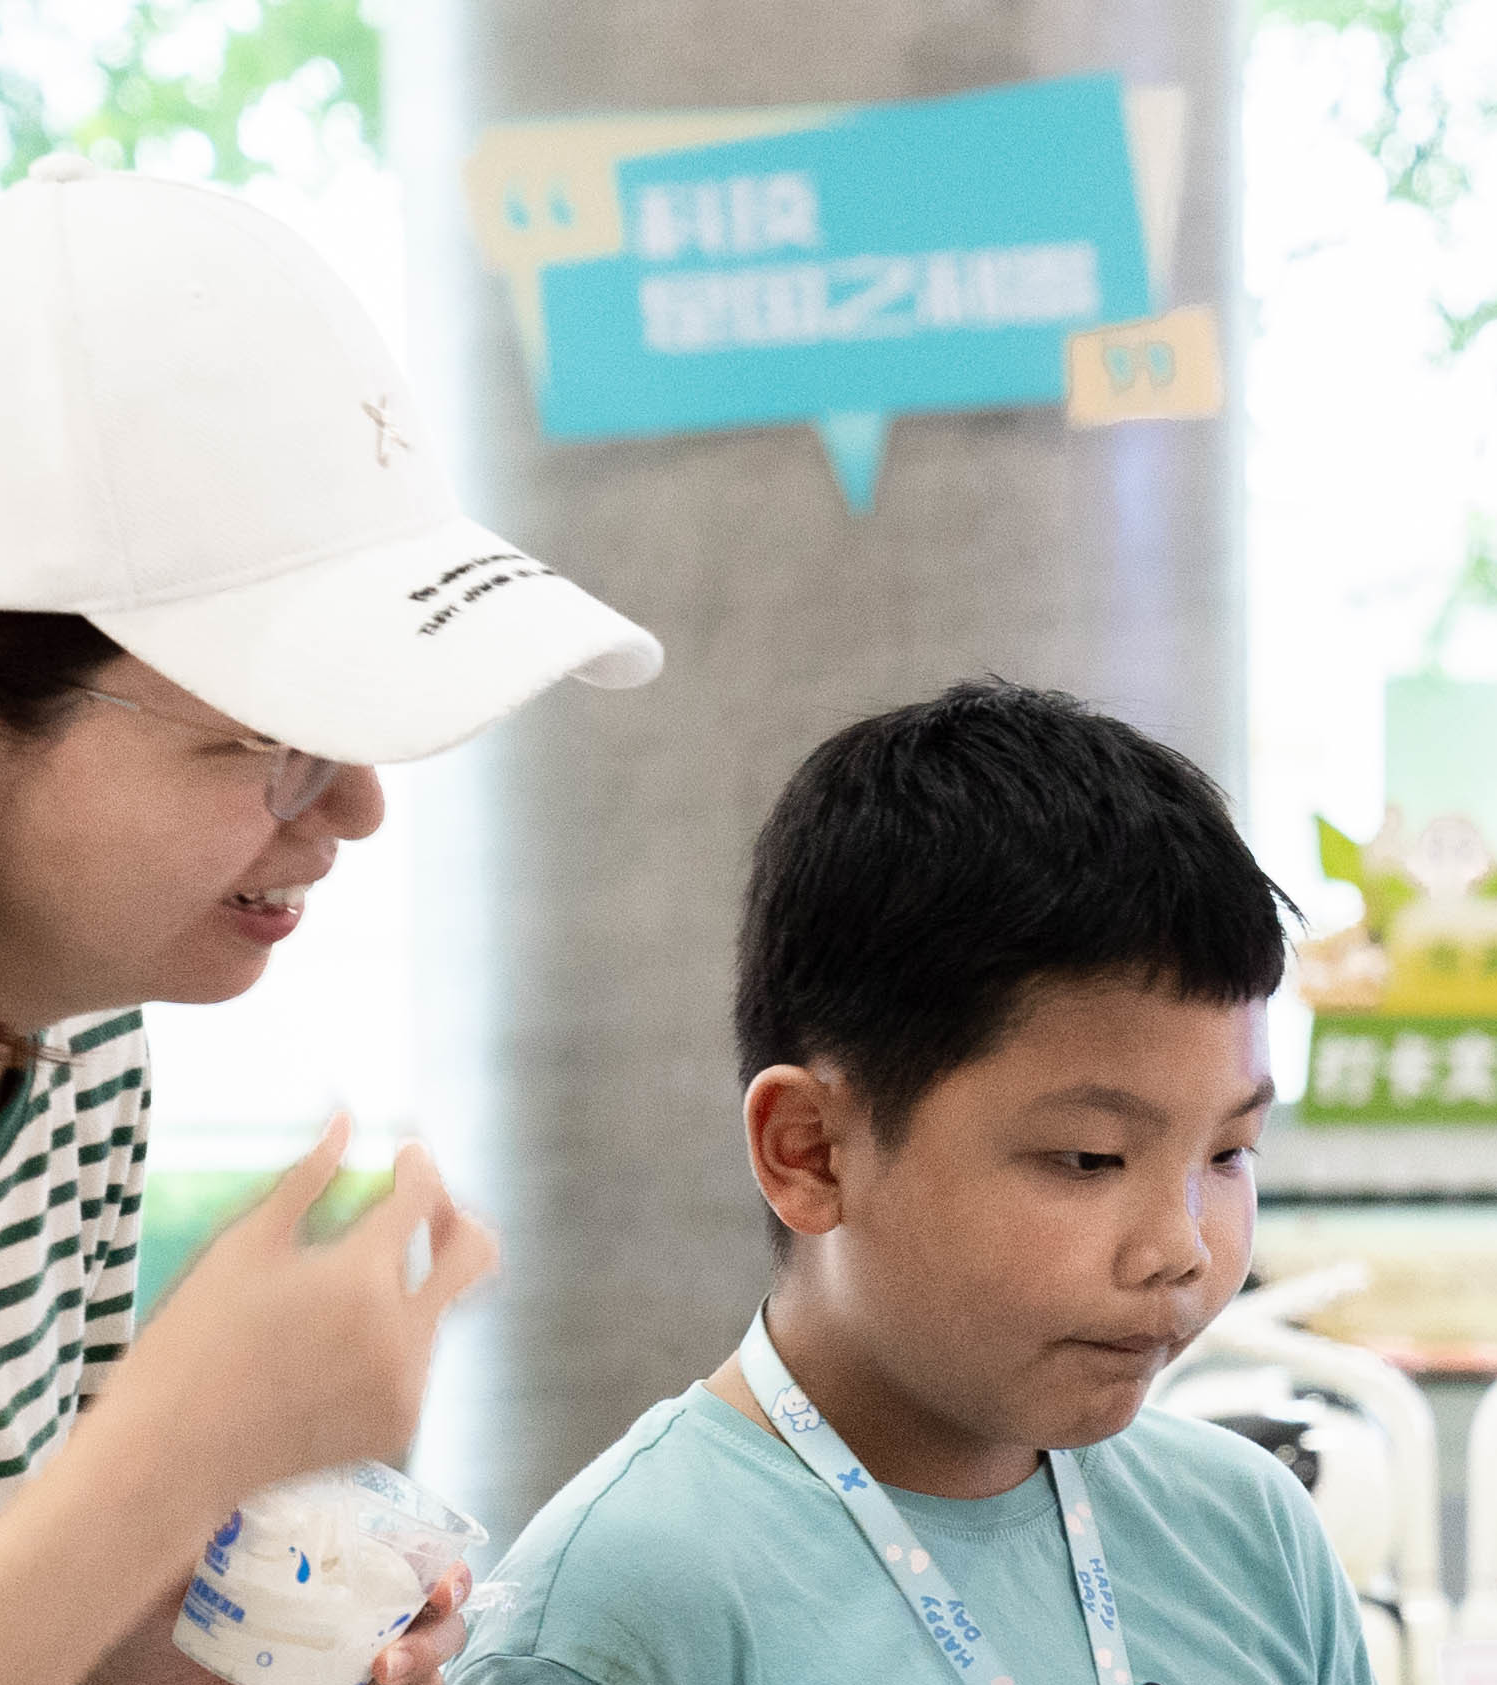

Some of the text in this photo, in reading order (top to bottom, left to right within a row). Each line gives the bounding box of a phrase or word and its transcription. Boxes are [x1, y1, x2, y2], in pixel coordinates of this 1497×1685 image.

[947, 1599, 982, 1642] DAY
[1077, 1570, 1096, 1614] DAY
[1089, 1557, 1114, 1631] HAPPY
[920, 1595, 975, 1669] HAPPY
